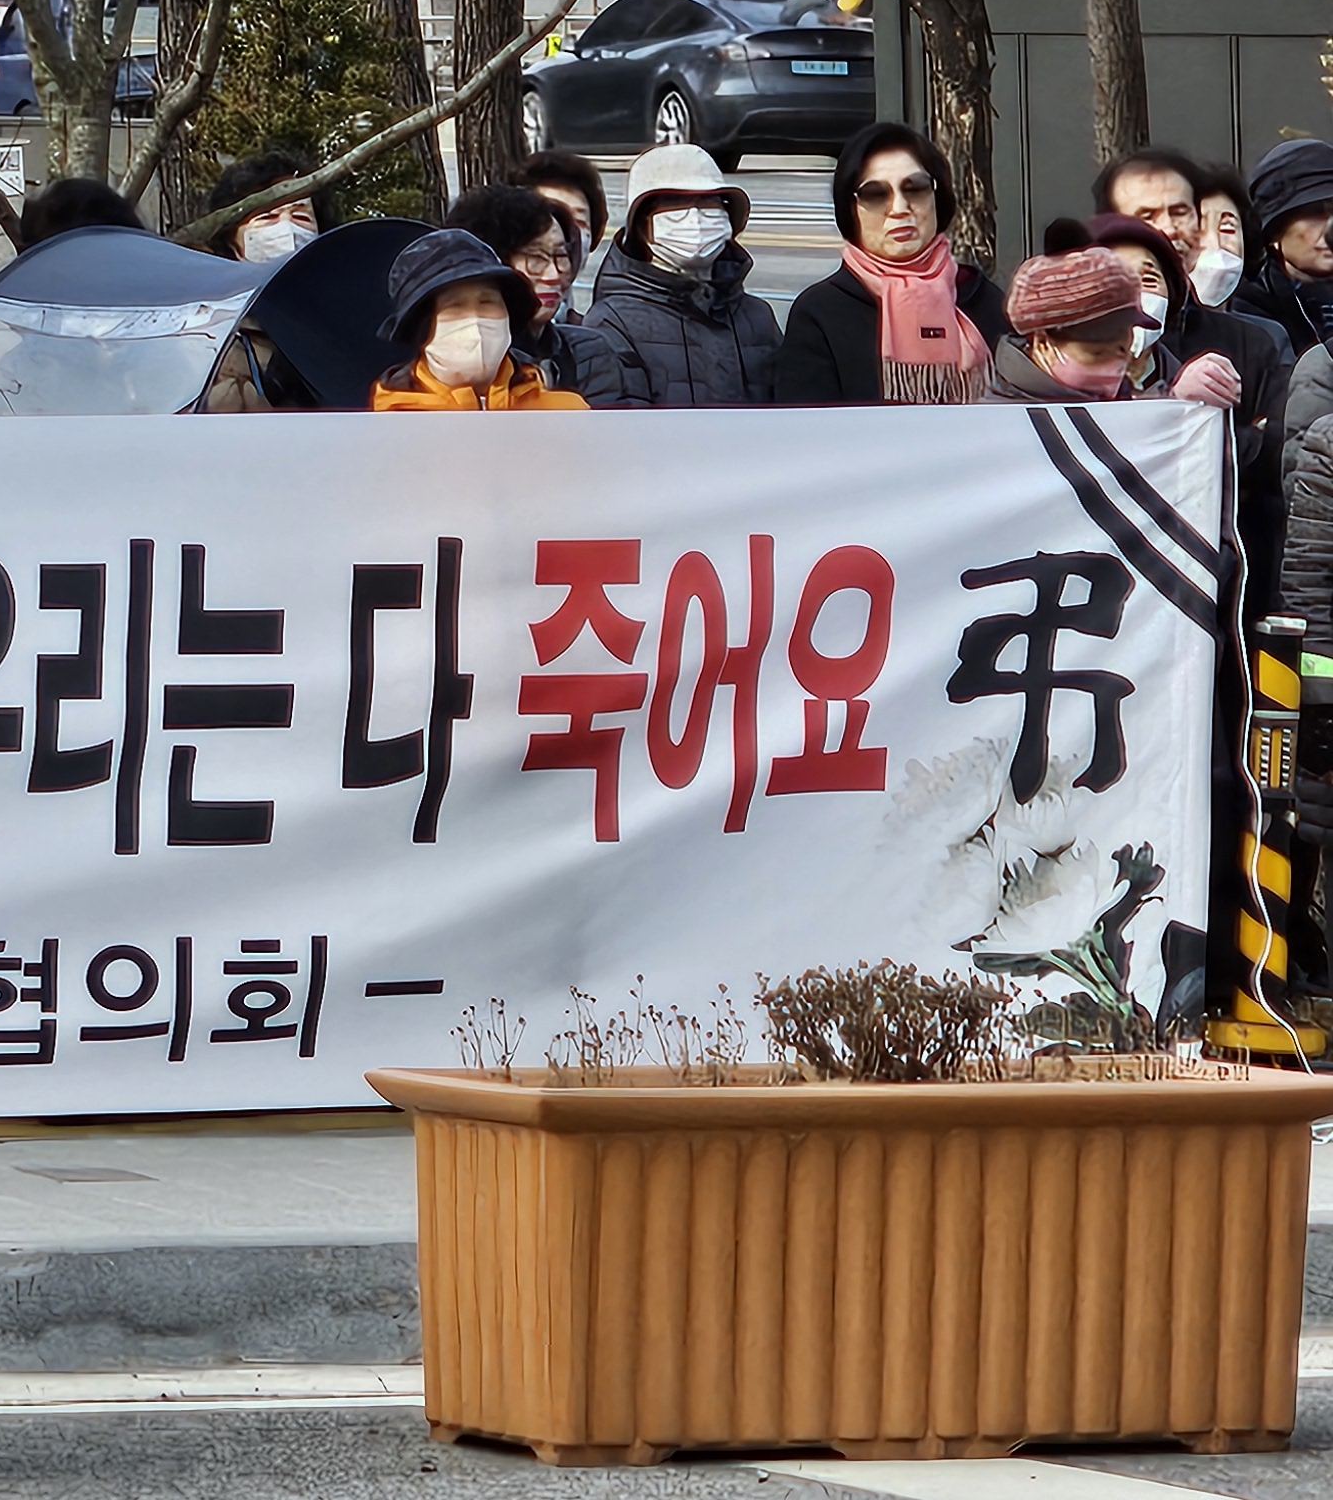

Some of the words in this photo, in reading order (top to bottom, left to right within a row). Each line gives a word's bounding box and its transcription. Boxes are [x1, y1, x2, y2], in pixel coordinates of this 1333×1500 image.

[342, 536, 475, 844] 다
[519, 535, 895, 843] 죽어요
[947, 550, 1136, 806] 弔
